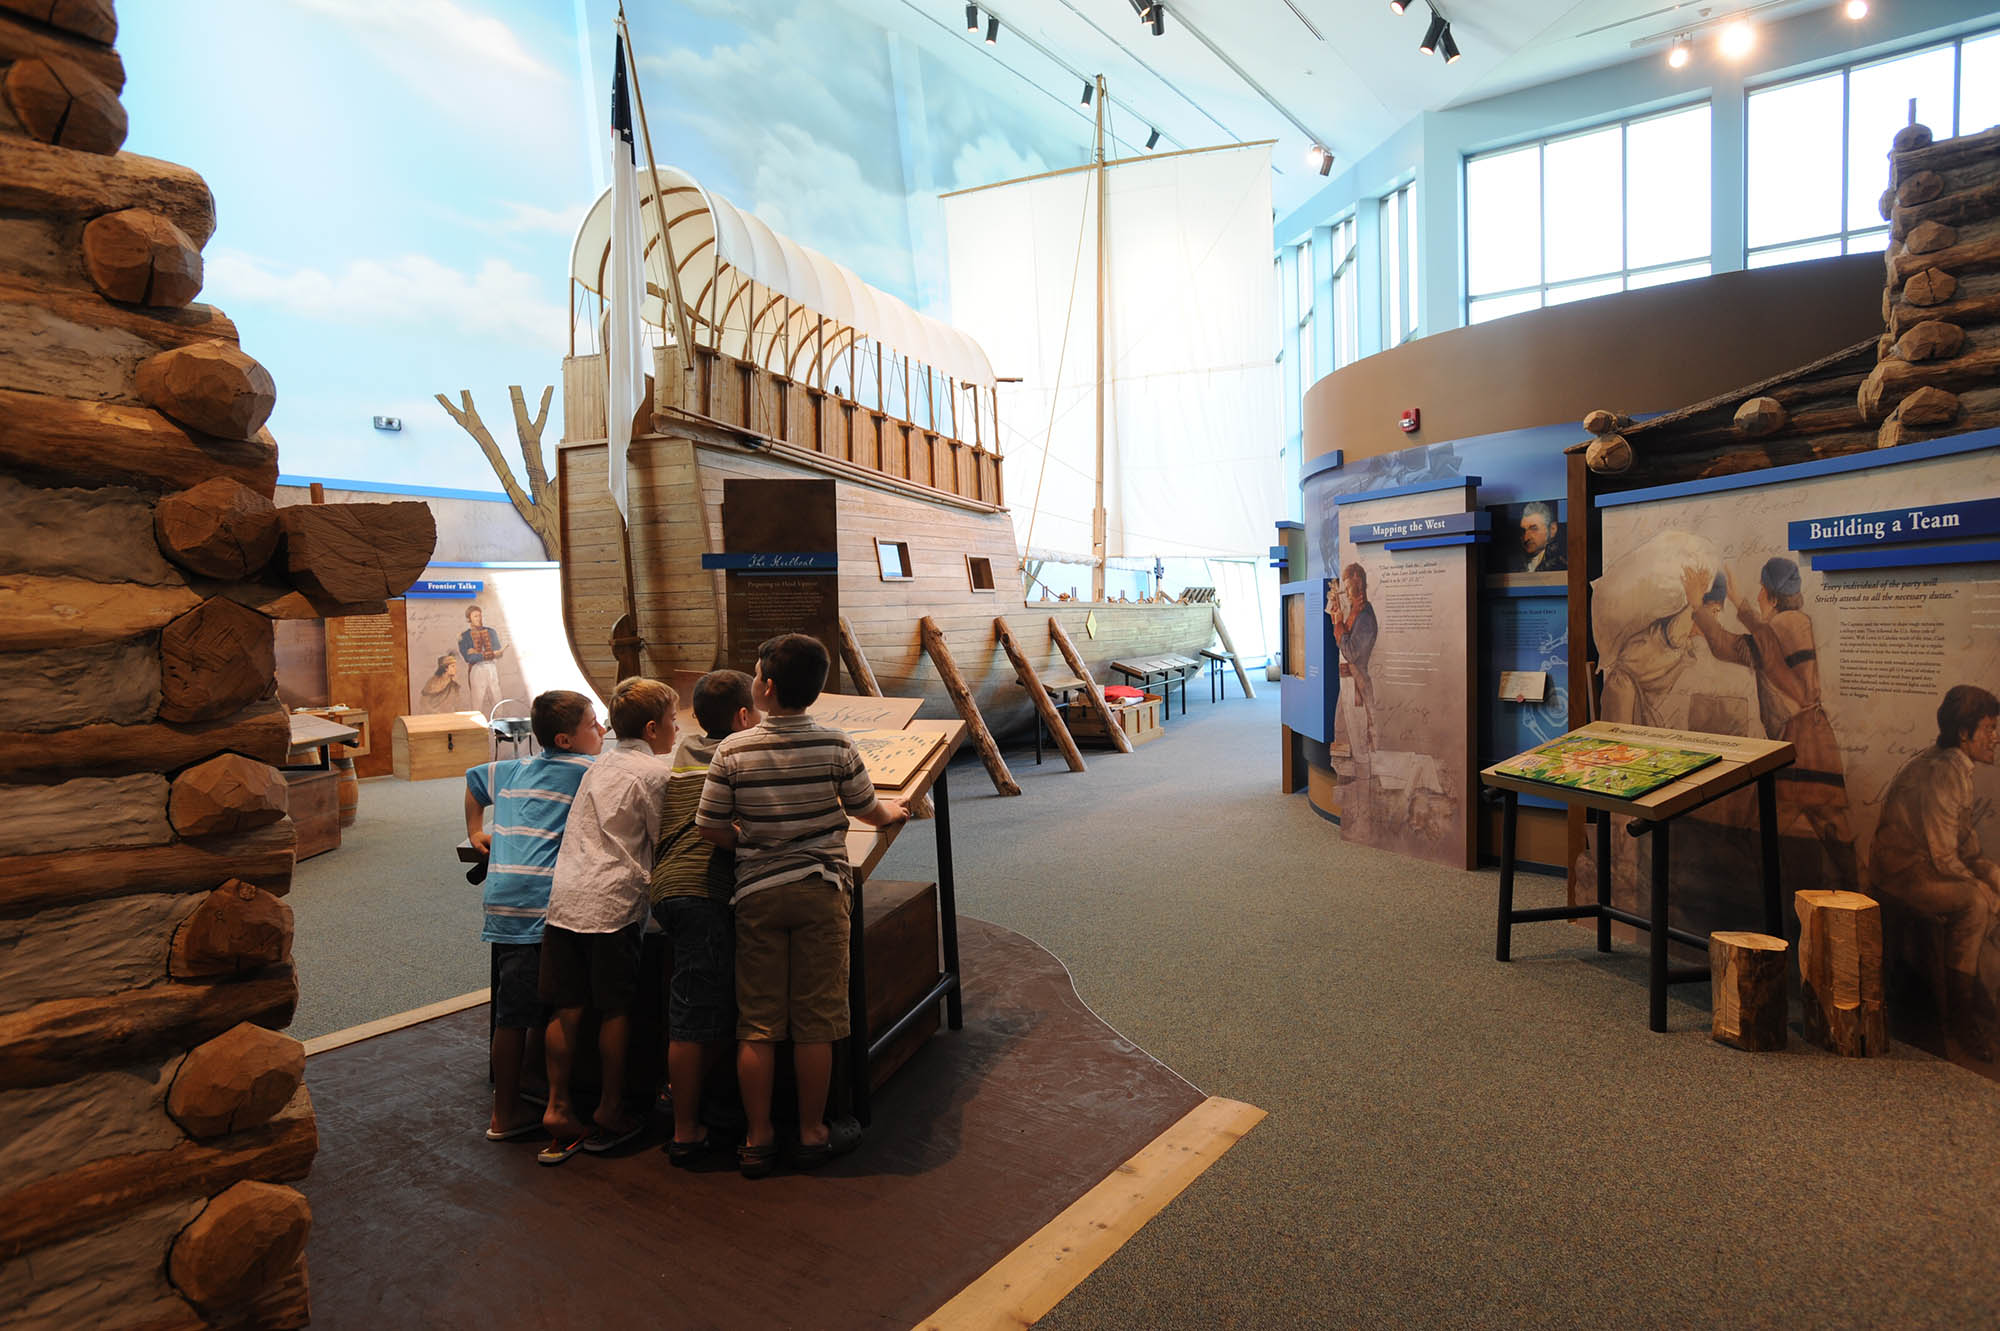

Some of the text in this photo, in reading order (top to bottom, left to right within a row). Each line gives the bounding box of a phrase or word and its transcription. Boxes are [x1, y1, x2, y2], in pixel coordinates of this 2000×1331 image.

[1372, 519, 1445, 537] Mapping the West
[1809, 511, 1960, 539] Building a Team
[748, 554, 814, 568] The Keelboat
[427, 582, 476, 590] Frontier Talks
[1843, 581, 1878, 590] individual
[1880, 580, 1888, 590] of
[1889, 580, 1900, 588] the
[1901, 580, 1921, 591] party
[1815, 594, 1838, 604] Strictly
[1839, 593, 1860, 602] attend
[1871, 592, 1881, 601] all
[1882, 592, 1894, 601] the
[1895, 592, 1928, 602] necessary
